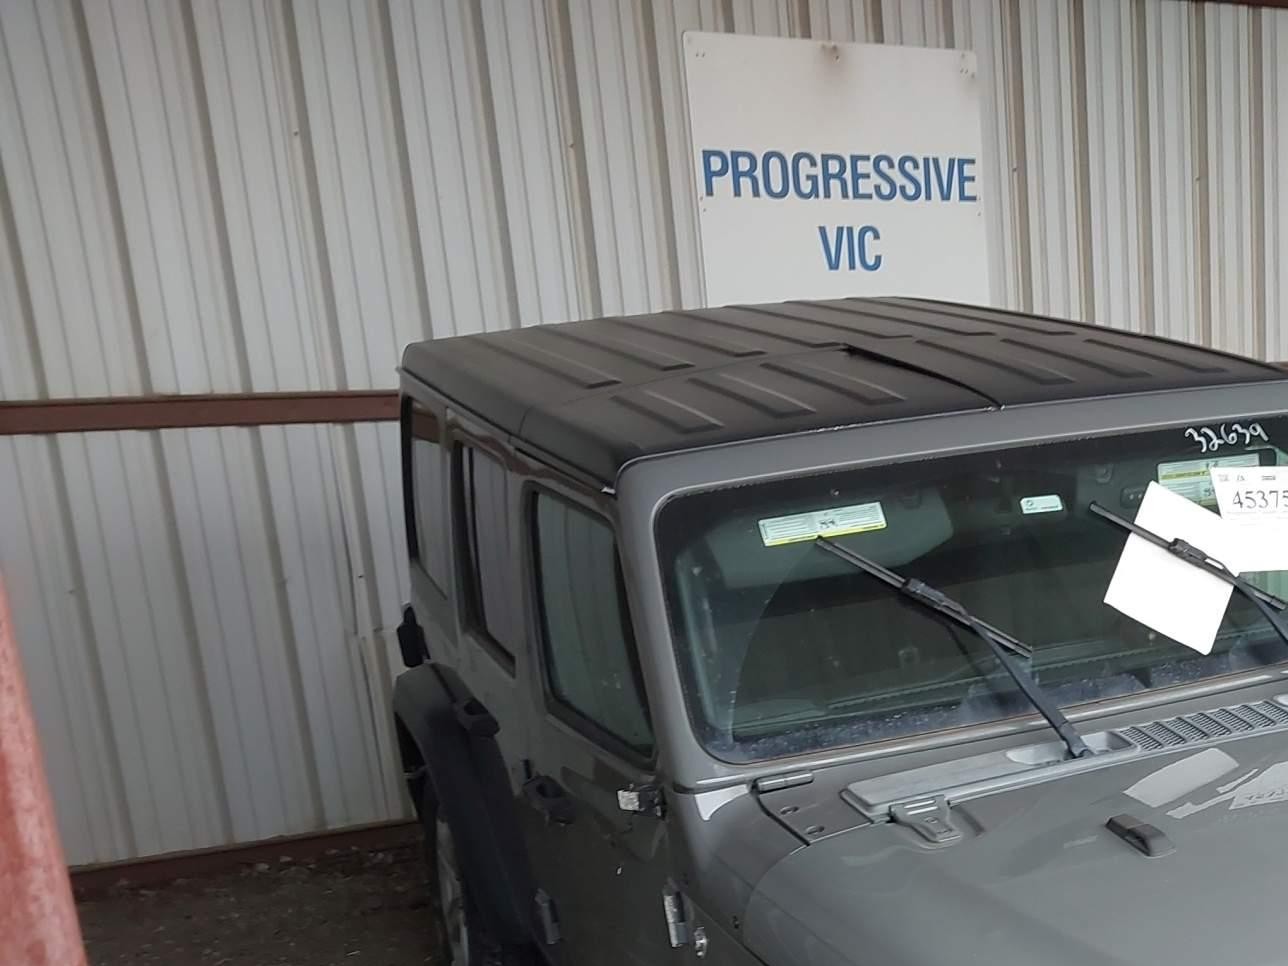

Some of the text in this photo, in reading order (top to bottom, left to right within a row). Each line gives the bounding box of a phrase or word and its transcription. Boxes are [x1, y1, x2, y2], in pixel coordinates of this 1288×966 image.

[701, 149, 978, 202] PROGRESSIVE
[818, 225, 883, 272] VIC
[1184, 422, 1269, 453] 32639
